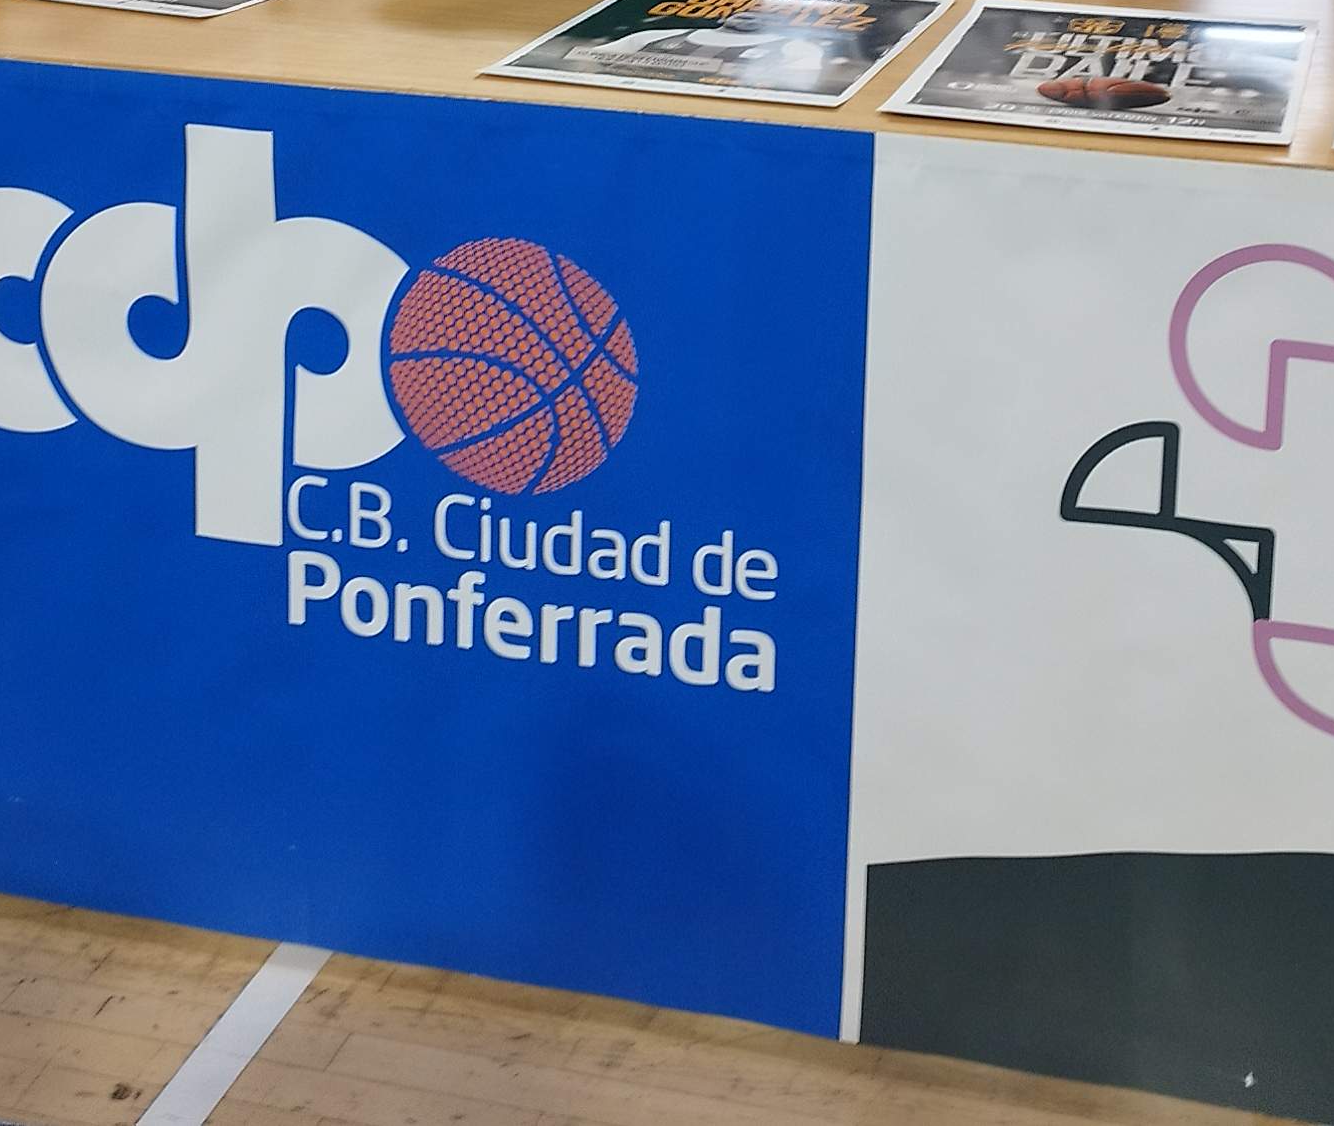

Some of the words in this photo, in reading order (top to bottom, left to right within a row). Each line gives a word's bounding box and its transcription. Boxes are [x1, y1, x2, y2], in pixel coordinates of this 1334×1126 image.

[646, 0, 877, 33] GONLEZ
[287, 474, 411, 551] C.B.
[434, 491, 671, 588] Ciudad
[691, 528, 779, 601] de
[287, 549, 777, 693] Ponferrada
